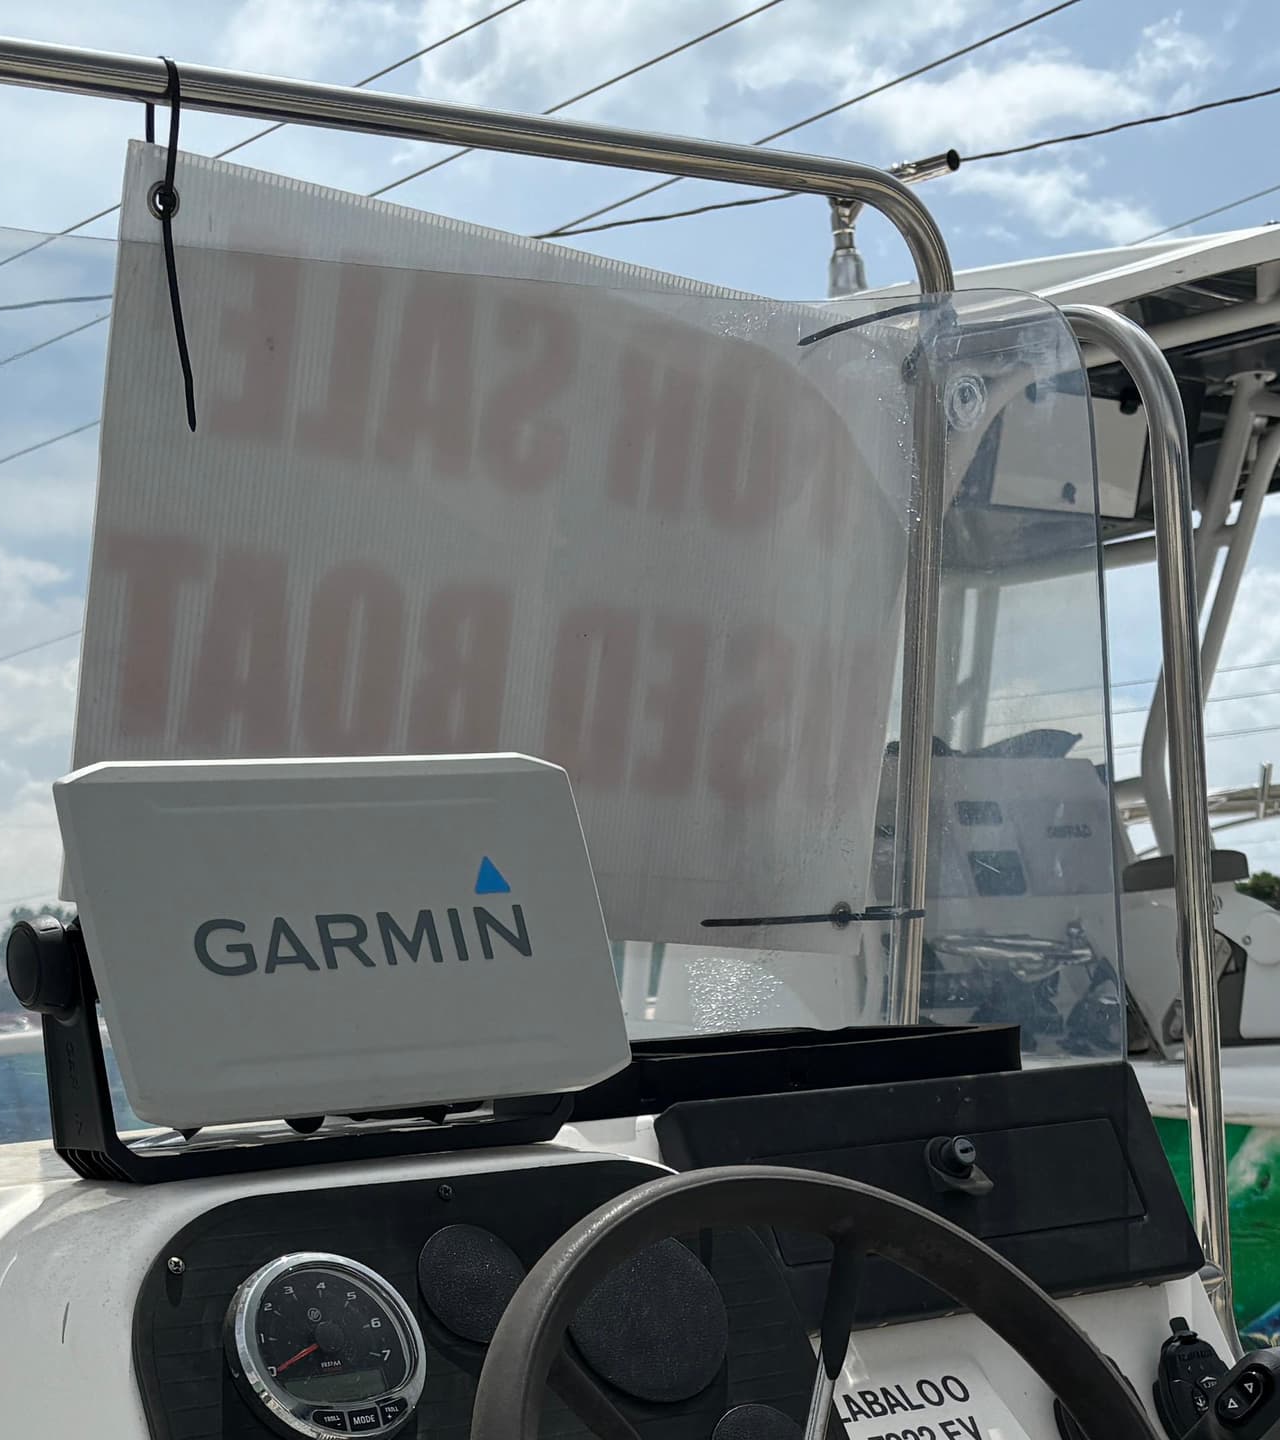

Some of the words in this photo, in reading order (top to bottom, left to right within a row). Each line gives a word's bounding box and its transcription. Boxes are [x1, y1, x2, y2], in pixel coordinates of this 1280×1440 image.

[194, 904, 533, 976] GARMIN
[283, 1286, 293, 1294] 3
[347, 1292, 357, 1300] 5
[264, 1303, 272, 1311] 2
[371, 1318, 381, 1328] 6
[382, 1350, 391, 1360] 7
[353, 1415, 375, 1425] MODE
